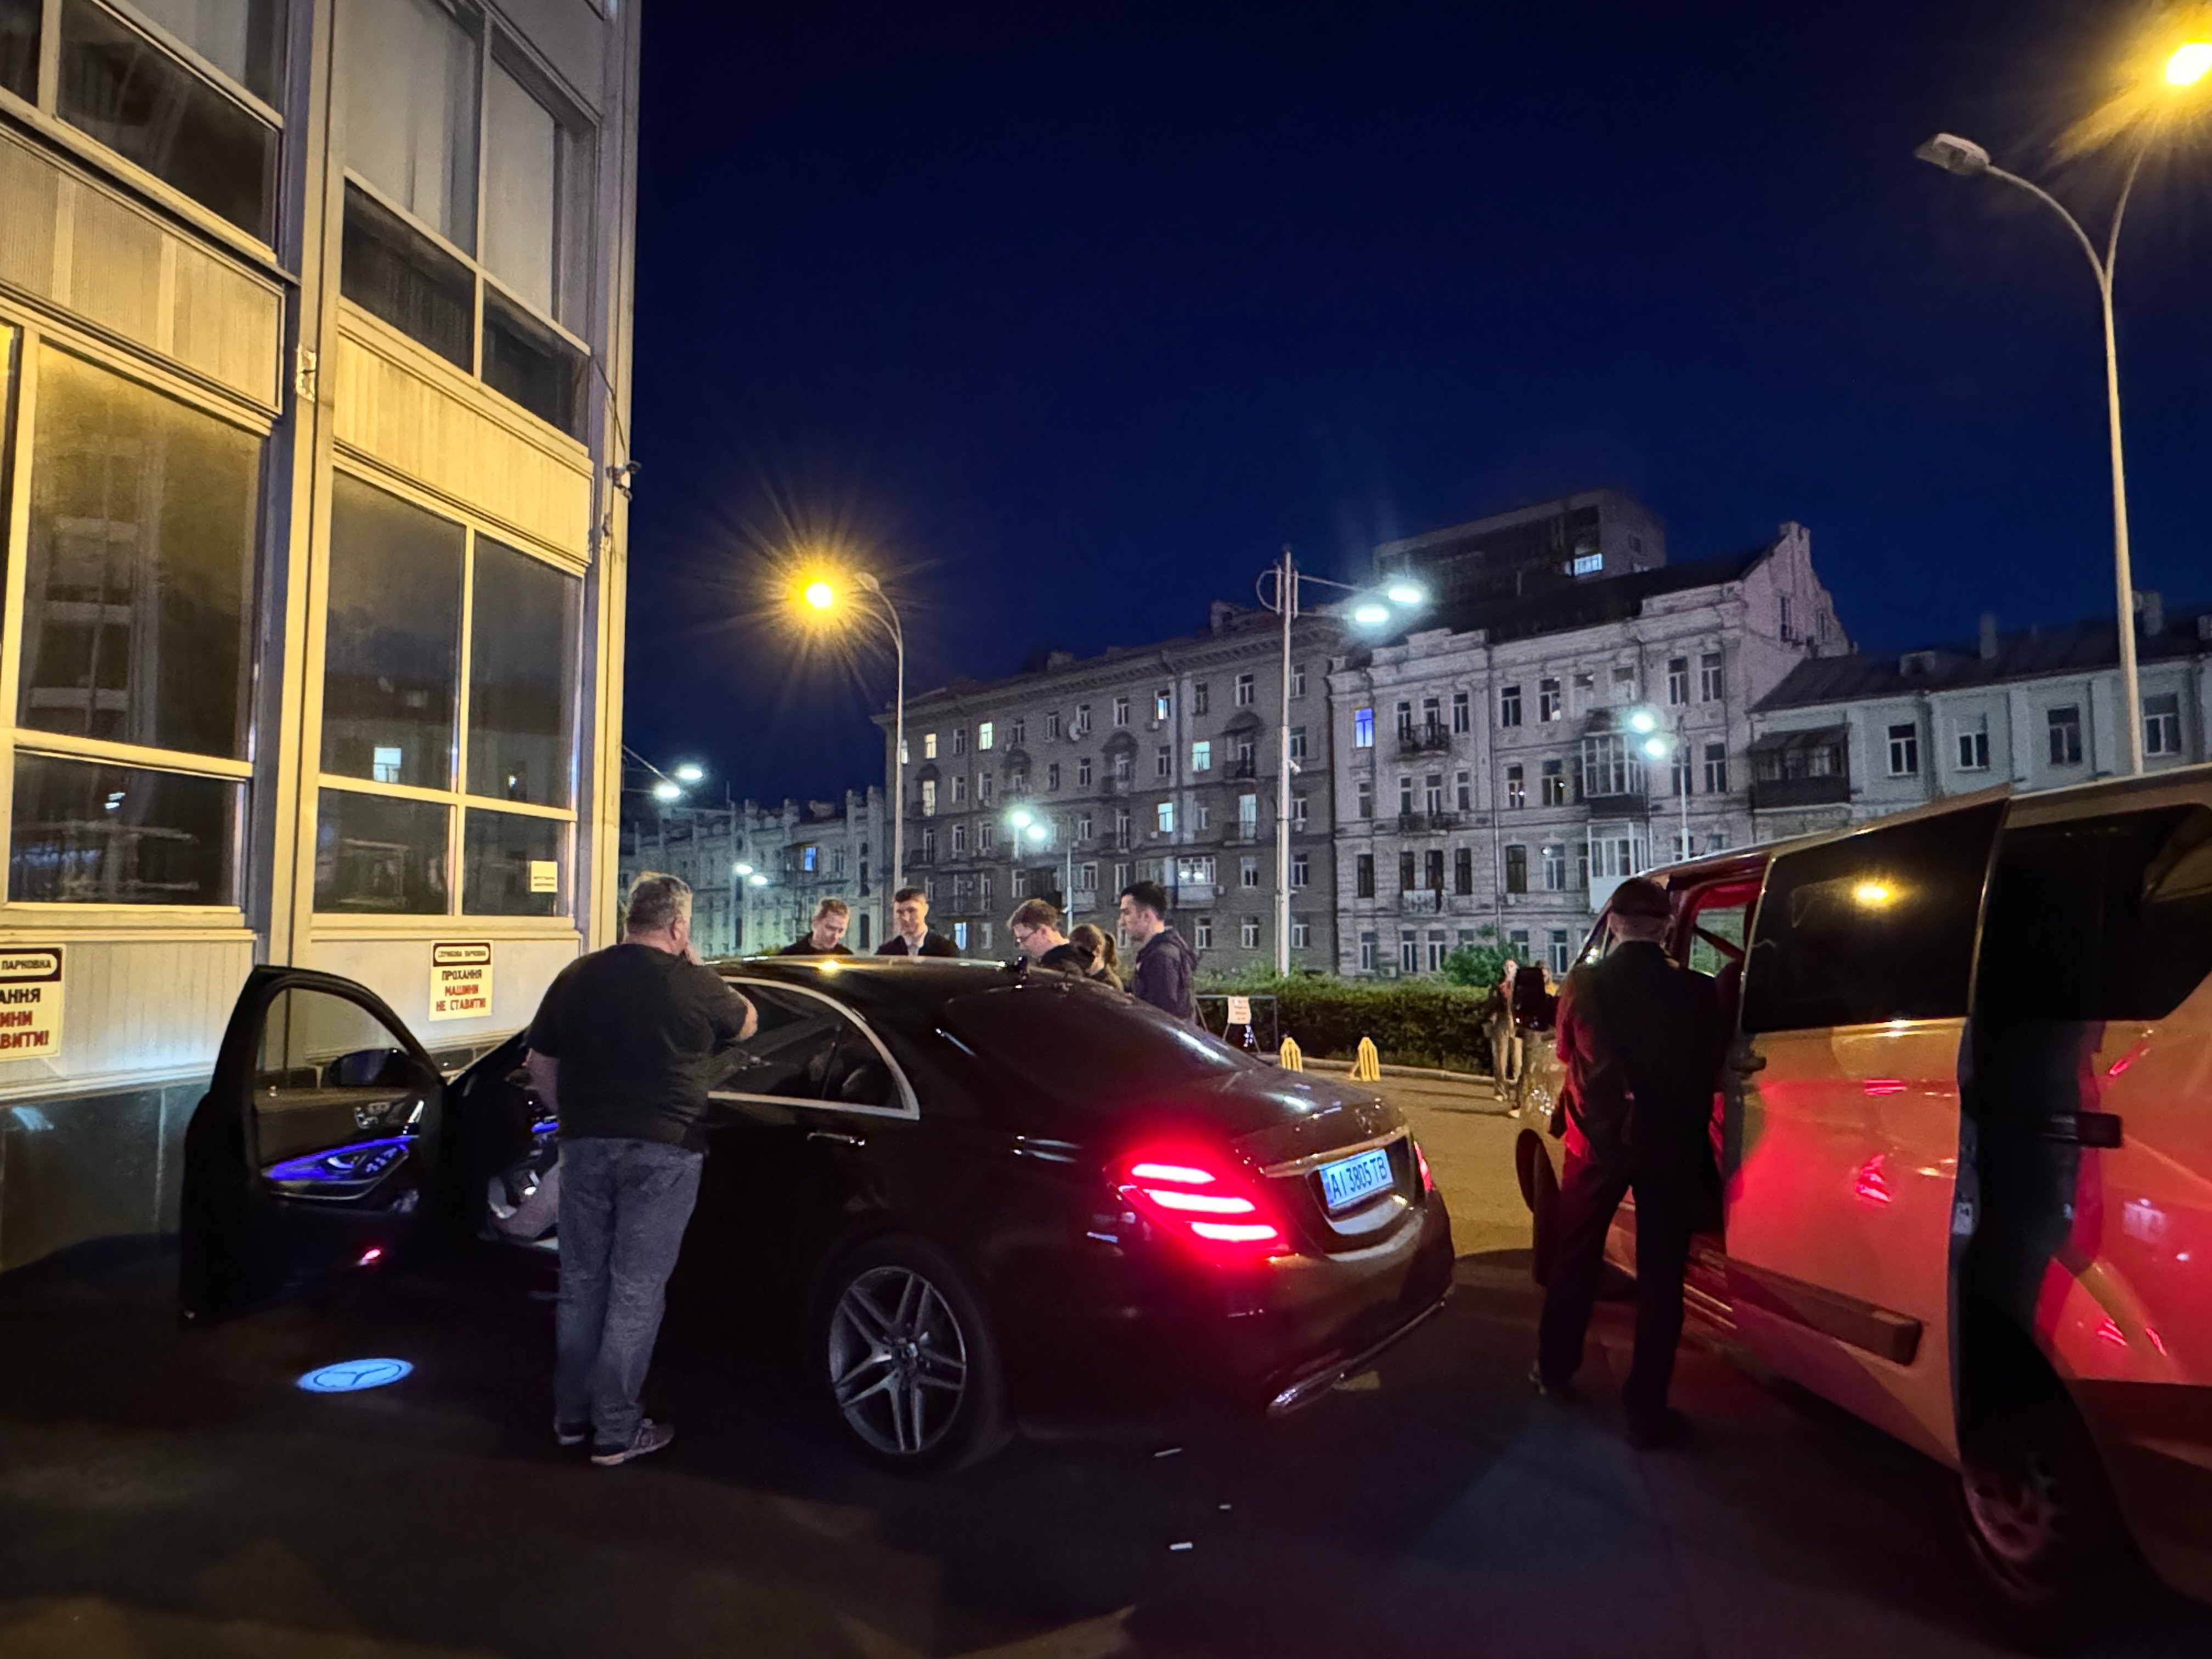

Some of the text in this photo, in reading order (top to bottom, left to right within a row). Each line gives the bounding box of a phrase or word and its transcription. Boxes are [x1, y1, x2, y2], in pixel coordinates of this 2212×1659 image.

[2, 960, 51, 970] ПАРКОВКА
[442, 969, 482, 981] ПРОХАННЯ
[445, 984, 479, 997] МАШИНИ
[436, 1000, 446, 1012] НЕ
[0, 1030, 49, 1049] ВИТИ!
